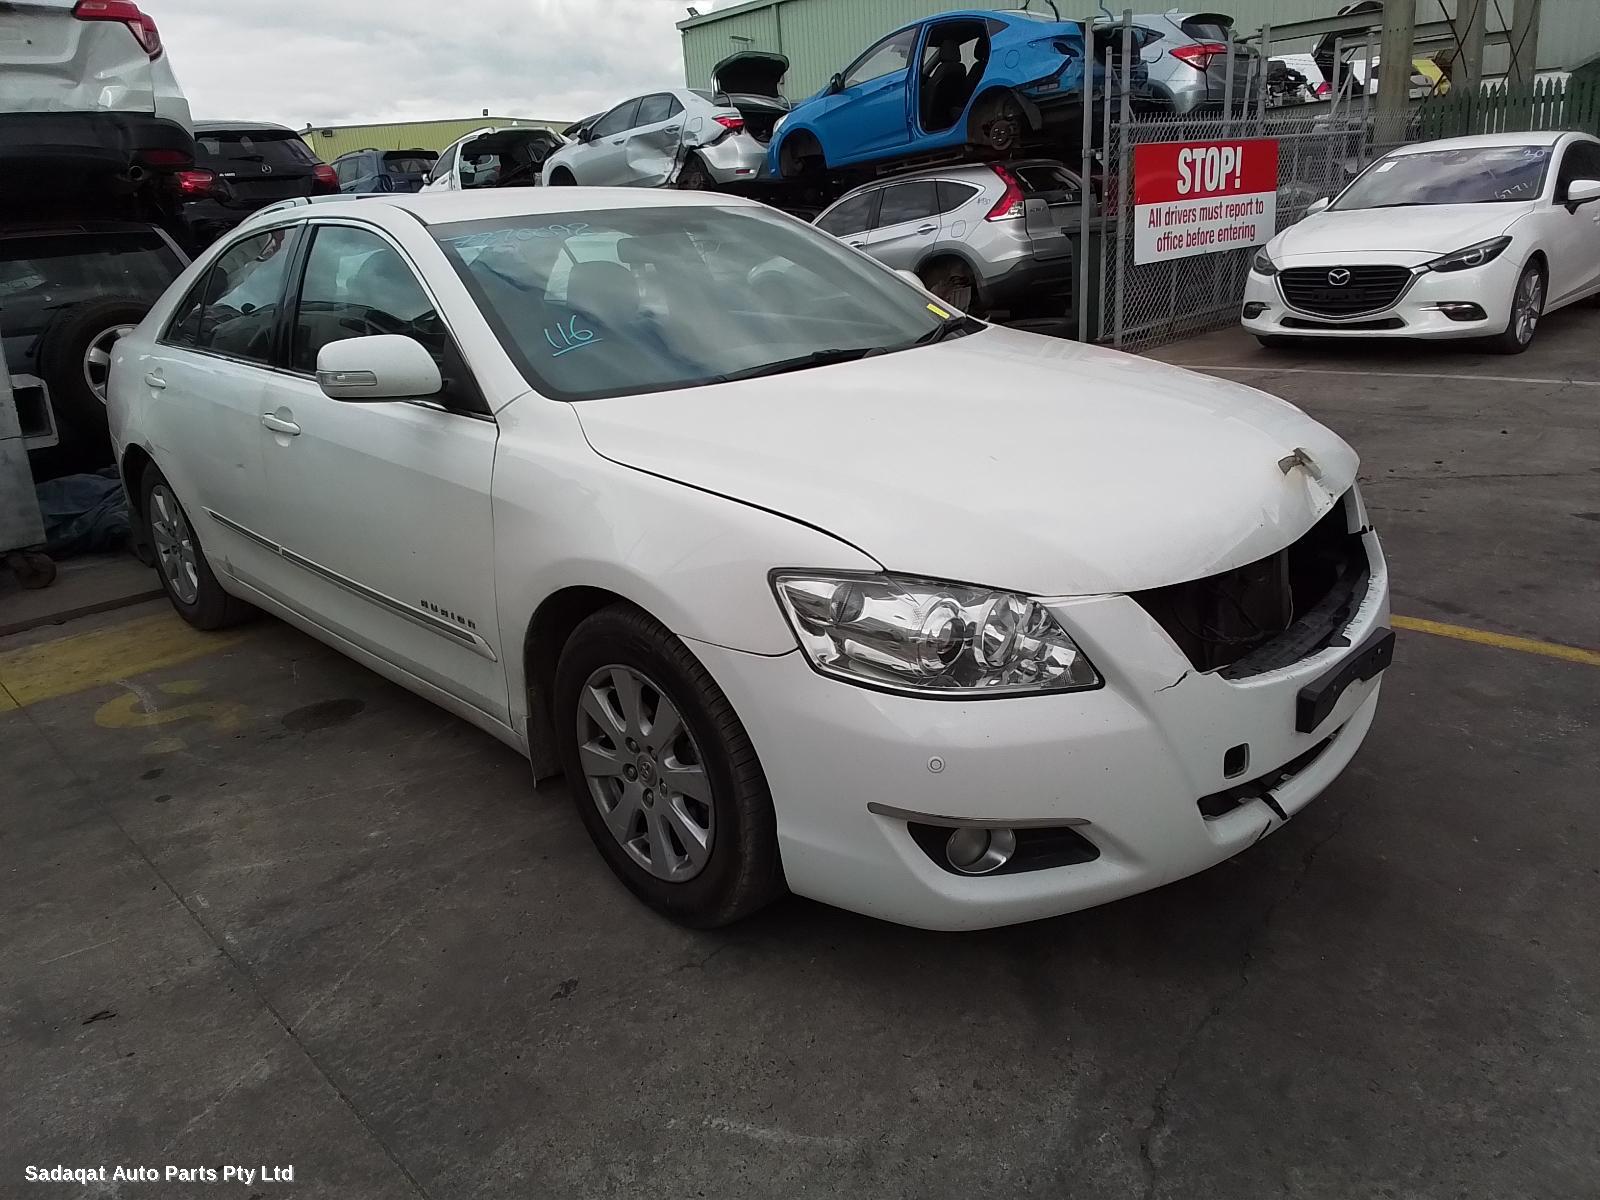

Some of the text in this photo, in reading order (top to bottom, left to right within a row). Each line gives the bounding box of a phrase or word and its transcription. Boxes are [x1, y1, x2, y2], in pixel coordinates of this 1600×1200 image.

[1176, 146, 1243, 195] STOP!
[1148, 197, 1265, 229] All drivers must report to
[1156, 221, 1256, 253] office before entering
[543, 314, 594, 349] 116
